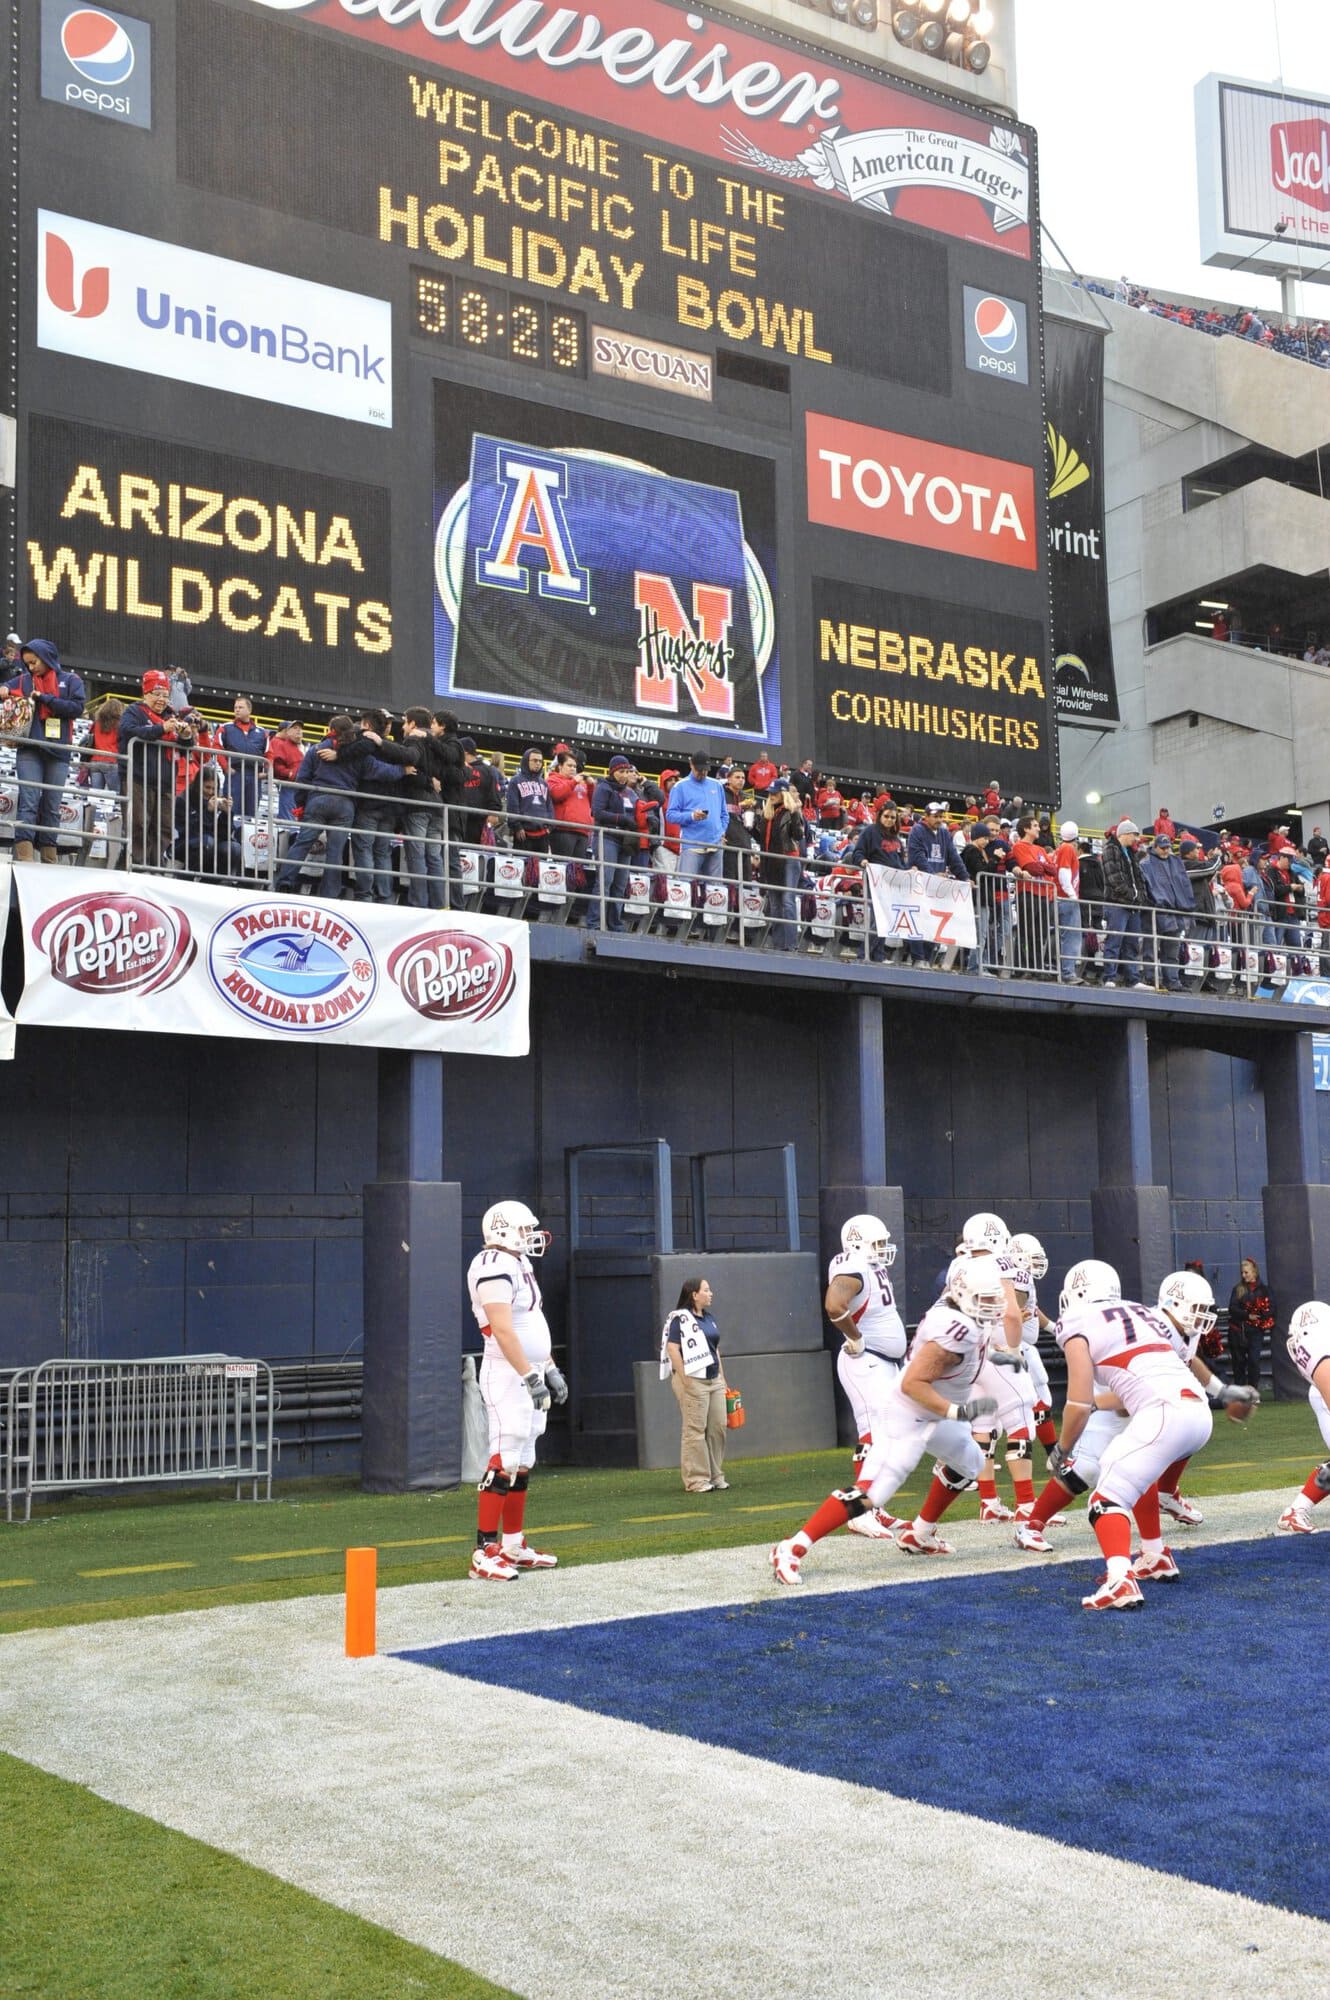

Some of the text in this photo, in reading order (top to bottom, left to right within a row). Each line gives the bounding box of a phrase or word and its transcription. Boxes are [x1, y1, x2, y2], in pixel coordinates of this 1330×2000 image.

[65, 83, 131, 115] pepsi
[408, 74, 786, 231] WELCOME TO THE
[904, 130, 958, 150] The Great
[852, 146, 1023, 201] American Lager
[438, 139, 757, 279] PACIFIC LIFE
[1301, 215, 1329, 235] the
[377, 186, 833, 365] HOLIDAY BOWL
[135, 285, 386, 384] UnionBank
[417, 277, 579, 368] 58:29
[595, 337, 711, 391] SYCUAN
[978, 354, 1017, 375] pepsi
[60, 464, 366, 573] ARIZONA
[818, 448, 1027, 542] TOYOTA
[1050, 521, 1100, 560] rint
[26, 540, 393, 654] WILDCATS
[638, 605, 735, 692] Huskers
[818, 617, 1046, 699] NEBRASKA
[830, 688, 1040, 751] CORNHUSKERS
[1056, 695, 1094, 711] Provider
[1071, 686, 1109, 703] Wireless
[576, 718, 659, 745] BOLT VISION
[55, 912, 166, 981] Pepper
[95, 907, 138, 946] Dr
[231, 908, 354, 951] PACIFIC LIFE
[413, 948, 497, 1007] Pepper
[438, 943, 473, 970] Dr
[222, 969, 366, 1025] HOLIDAY BOWL
[480, 1251, 500, 1266] 77
[945, 1320, 970, 1342] 78
